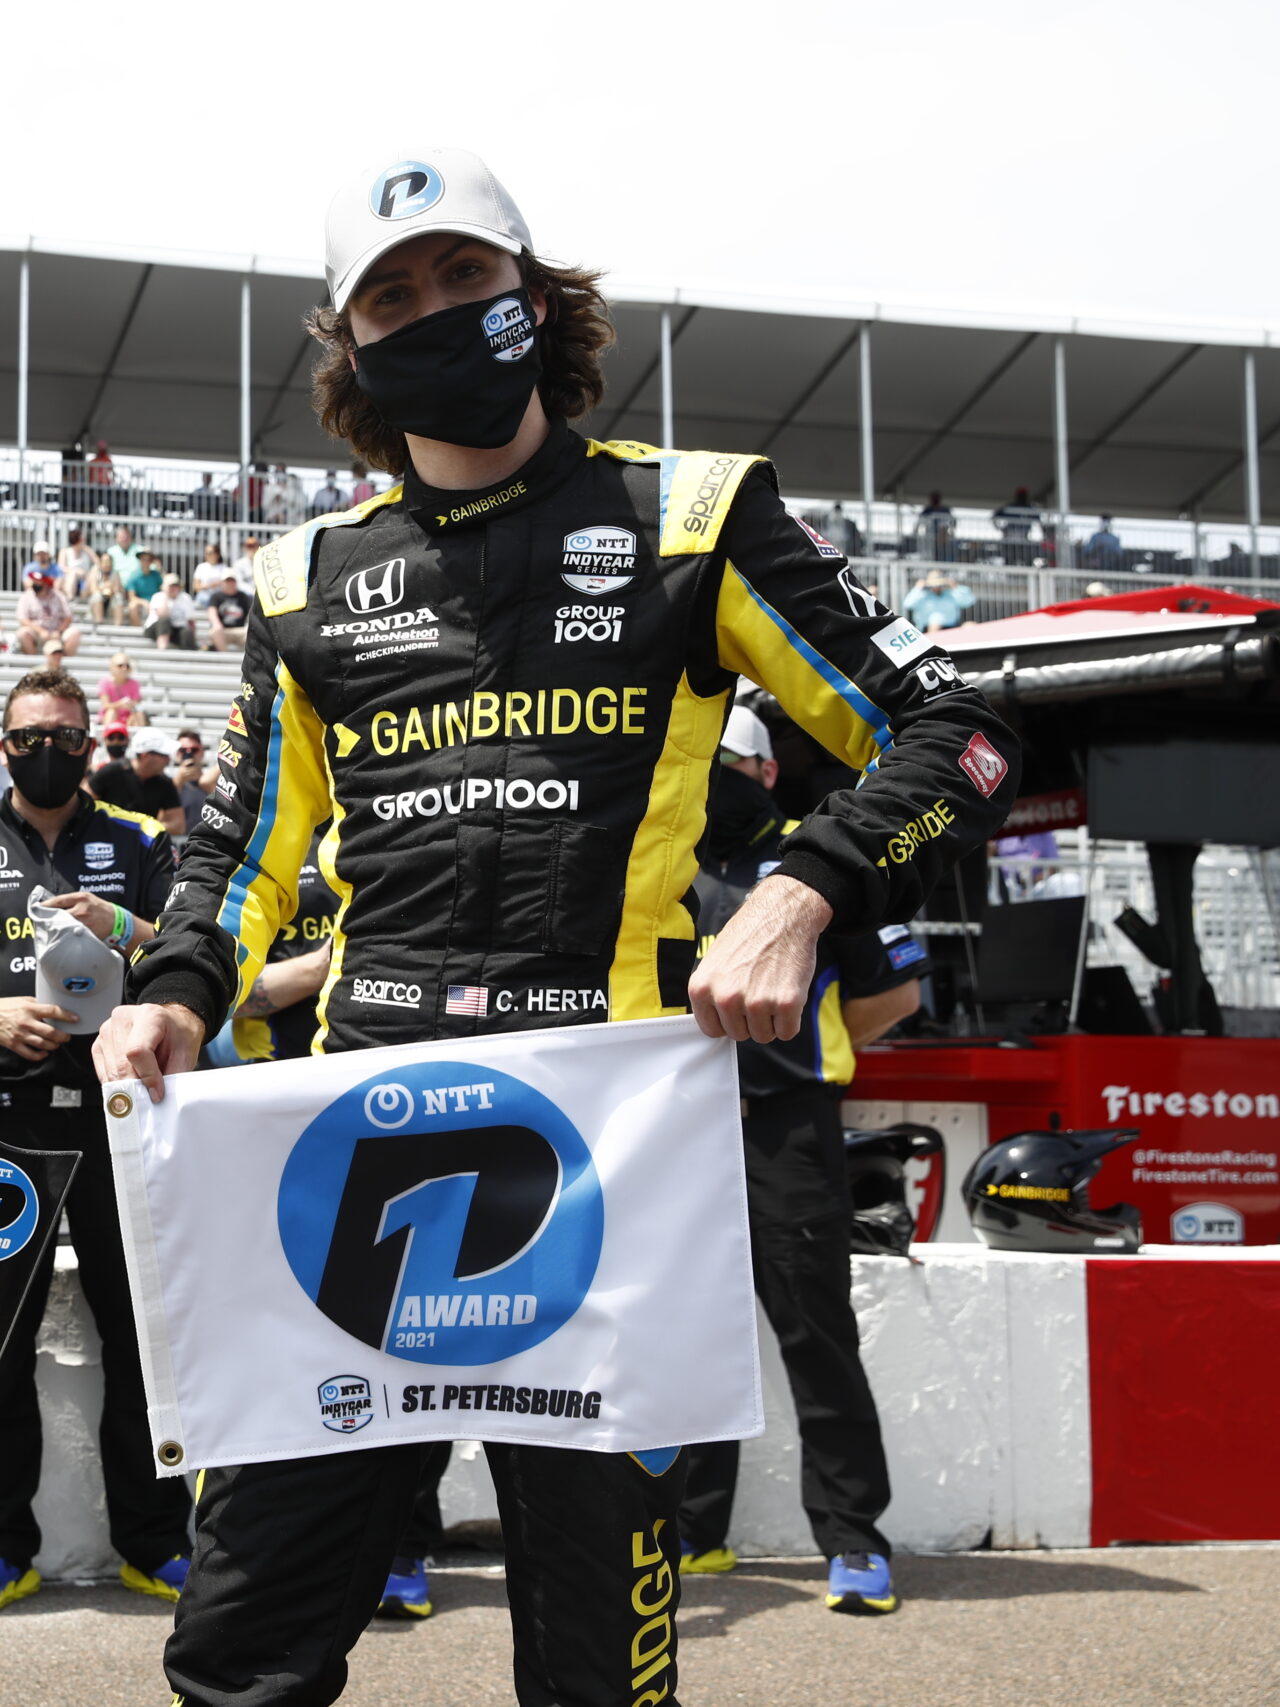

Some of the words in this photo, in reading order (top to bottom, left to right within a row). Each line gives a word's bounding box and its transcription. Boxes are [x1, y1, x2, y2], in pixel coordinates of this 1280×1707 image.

[503, 305, 521, 322] NTT
[489, 319, 531, 348] INDYCAR
[500, 333, 526, 349] SERIES
[450, 480, 527, 522] GAINBRIDGE
[683, 457, 737, 536] sparco
[596, 538, 629, 548] NTT
[563, 553, 635, 568] INDYCAR
[576, 566, 618, 575] SERIES
[320, 607, 439, 637] HONDA
[556, 605, 625, 620] GROUP
[353, 627, 439, 647] AutoNation
[554, 619, 622, 643] 1001
[355, 641, 439, 662] #CHECKIT4ANDRETTI
[371, 687, 647, 756] GAINBRIDGE
[964, 756, 990, 793] Speedway
[372, 779, 579, 821] GROUP1001
[352, 978, 422, 1006] sparco
[496, 990, 519, 1012] C.
[527, 989, 608, 1012] HERTA
[422, 1082, 495, 1116] NTT
[1101, 1085, 1280, 1123] Fireston
[1132, 1150, 1277, 1168] @FirestoneRacing
[1132, 1168, 1278, 1184] FirestoneTire.com
[998, 1184, 1070, 1202] GAINBRIDGE
[1204, 1220, 1235, 1234] NTT
[396, 1294, 537, 1328] AWARD
[395, 1331, 436, 1349] 2021
[340, 1383, 365, 1396] NTT
[321, 1399, 373, 1415] INDYCAR
[402, 1385, 436, 1413] ST.
[442, 1385, 602, 1419] PETERSBURG
